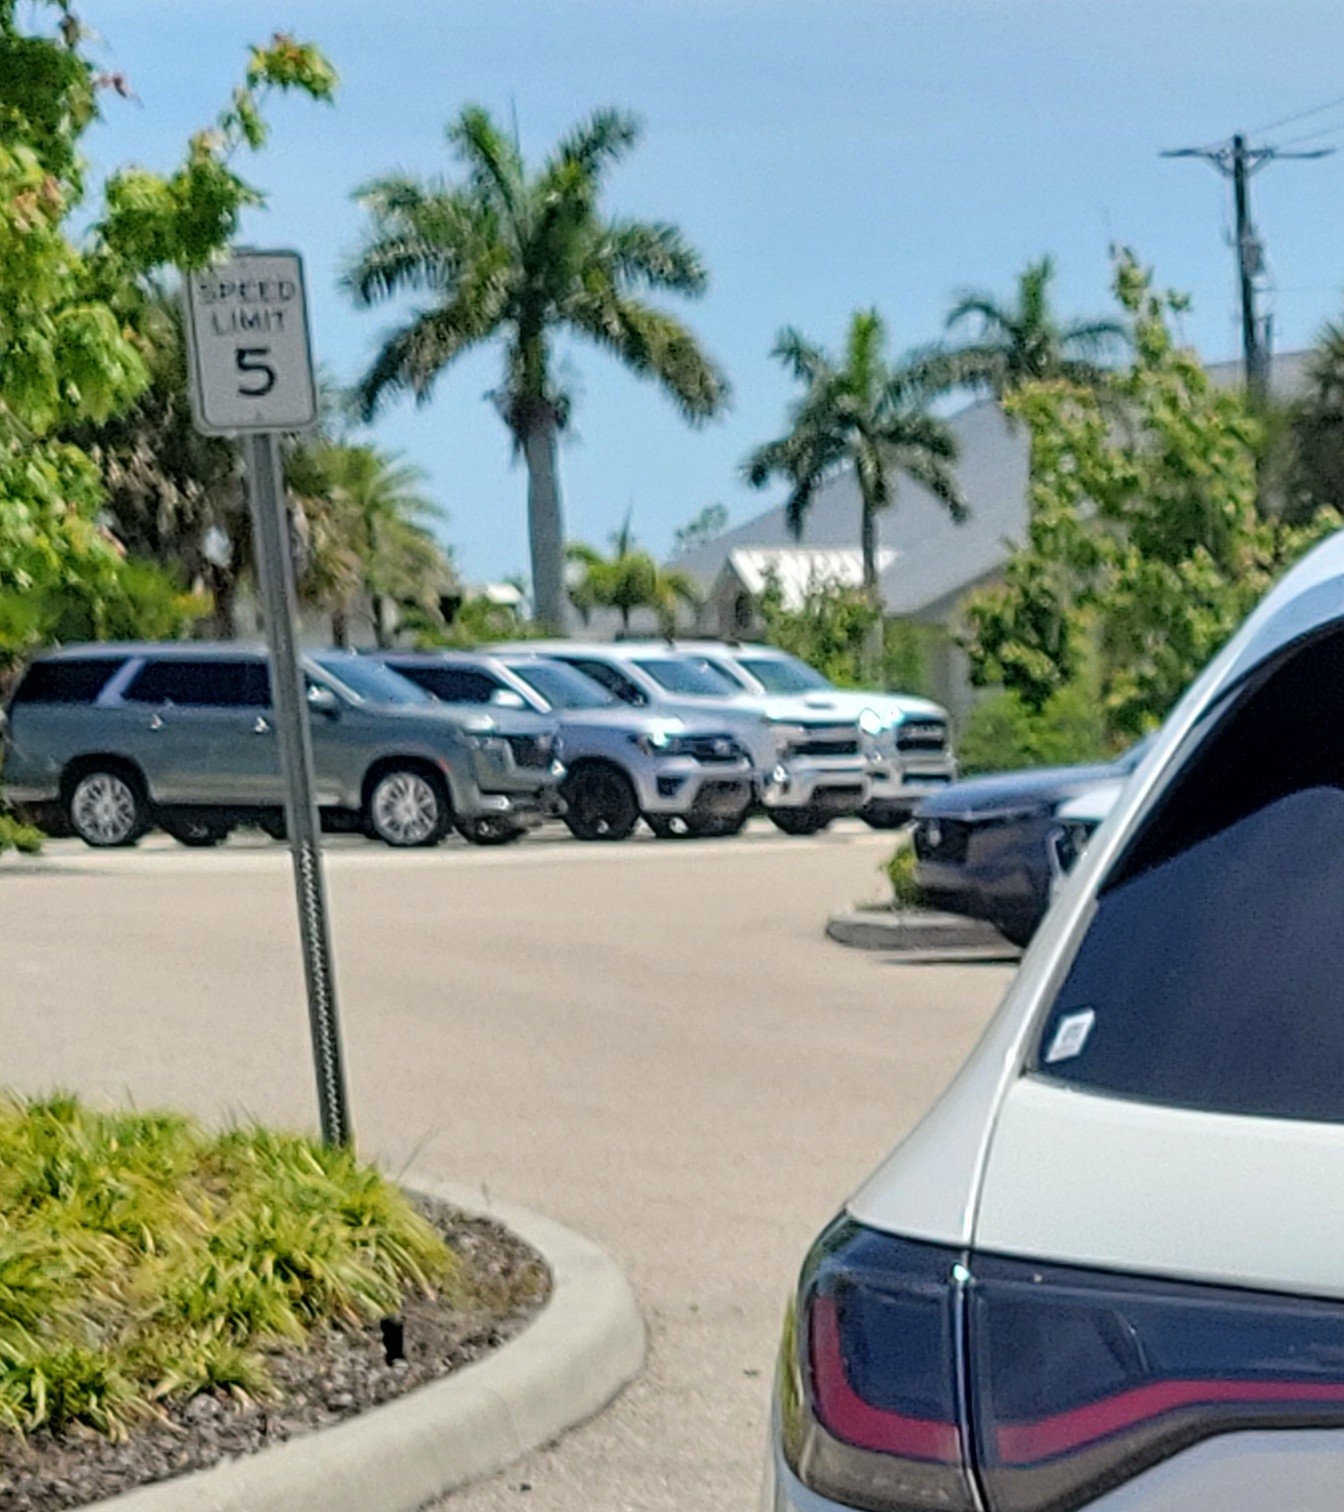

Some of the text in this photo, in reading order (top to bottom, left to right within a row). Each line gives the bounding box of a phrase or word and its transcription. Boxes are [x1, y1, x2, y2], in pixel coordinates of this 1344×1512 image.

[199, 280, 297, 302] SPEED
[211, 308, 285, 336] LIMIT
[235, 347, 277, 396] 5
